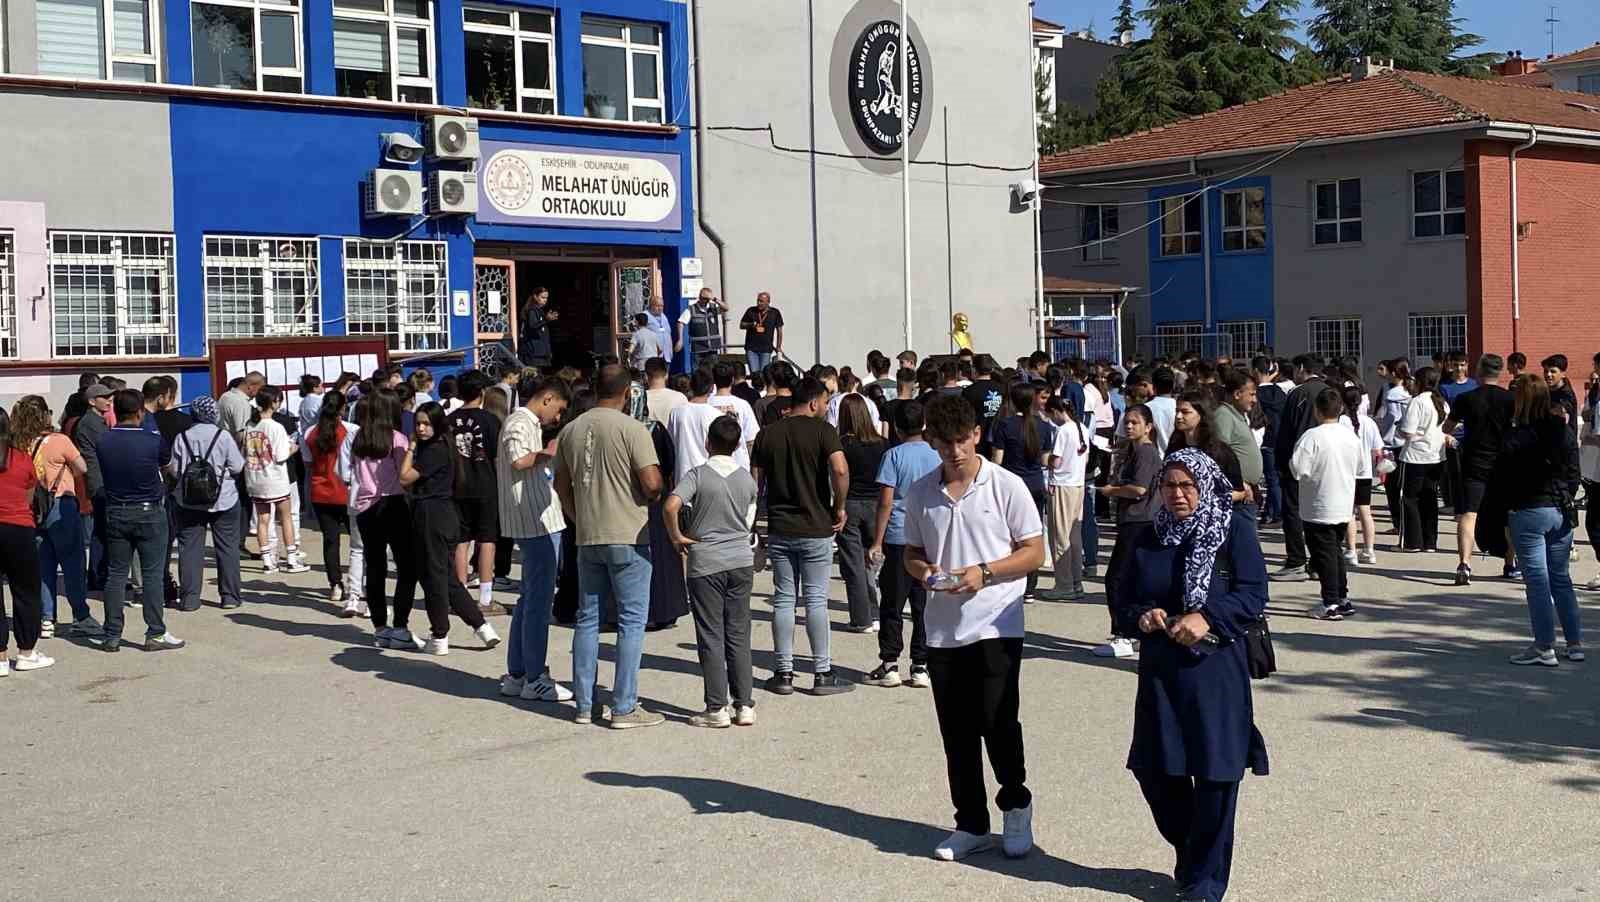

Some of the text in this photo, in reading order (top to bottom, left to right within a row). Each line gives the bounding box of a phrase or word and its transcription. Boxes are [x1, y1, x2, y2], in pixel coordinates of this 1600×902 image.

[857, 41, 871, 88] MELAHAT
[906, 40, 920, 94] TAOKULU
[860, 99, 892, 145] ODUNPAZARI
[541, 157, 577, 169] ESKİŞEHİR
[583, 160, 630, 171] ODUNPAZARI
[541, 175, 608, 194] MELAHAT
[611, 176, 669, 198] ÜNÜGÜR
[542, 197, 626, 217] ORTAOKULU
[458, 297, 465, 306] A
